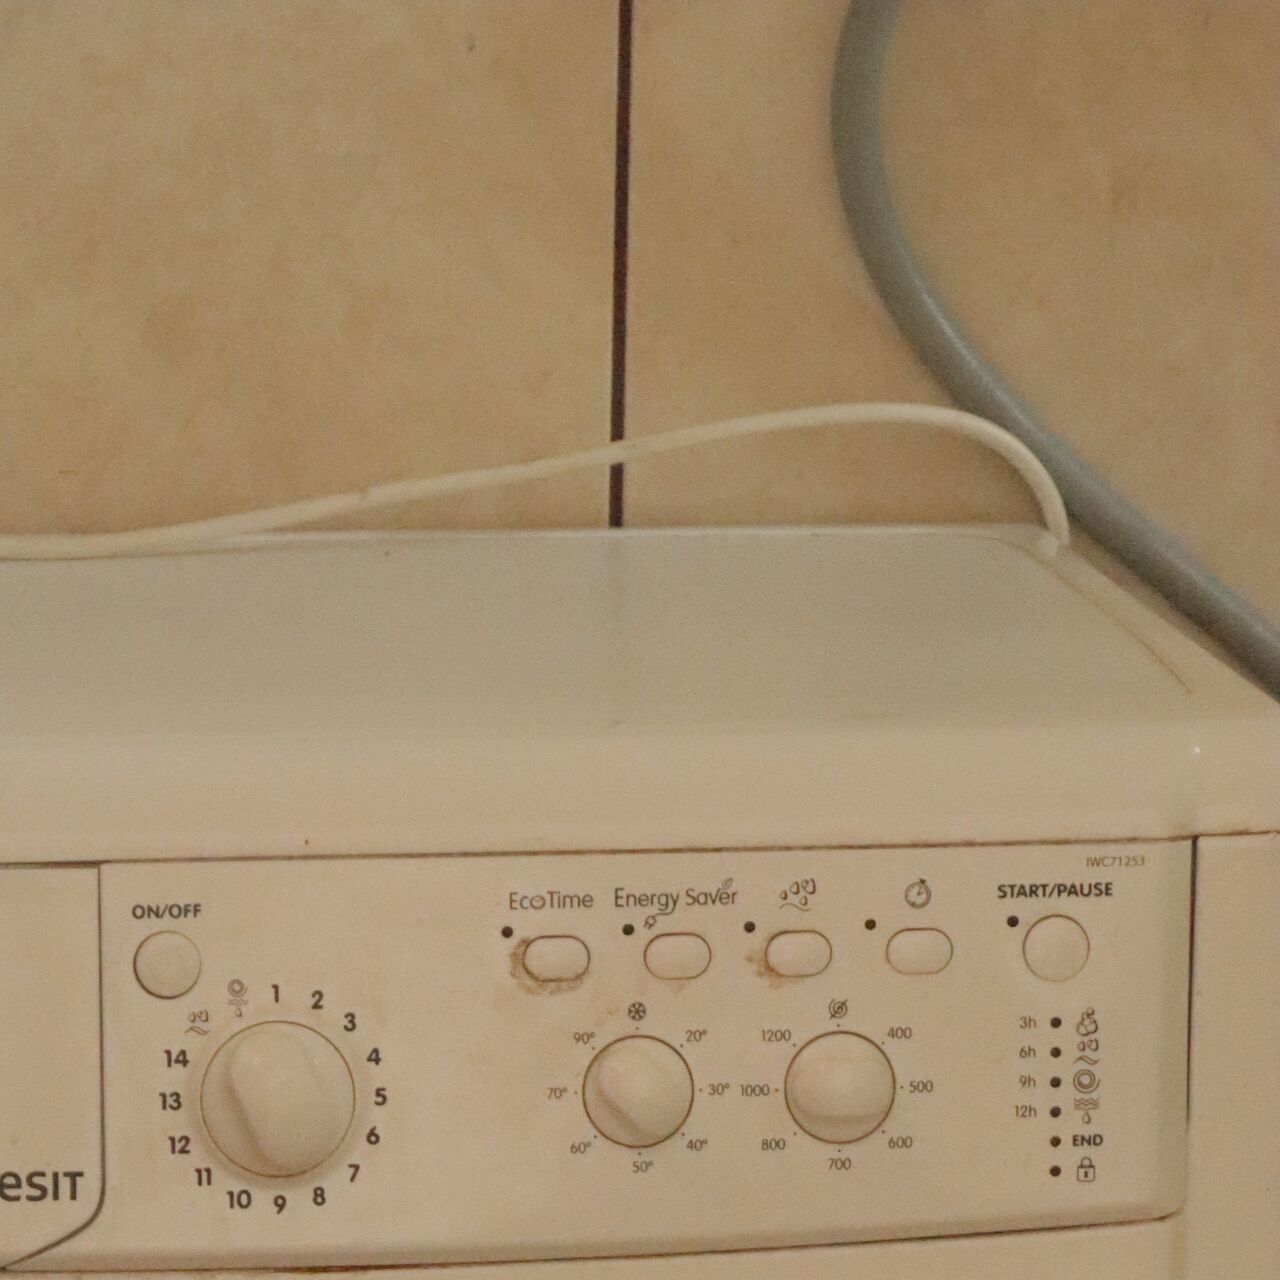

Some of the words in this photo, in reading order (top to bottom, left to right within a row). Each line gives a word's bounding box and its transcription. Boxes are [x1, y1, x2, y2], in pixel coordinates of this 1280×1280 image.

[1086, 855, 1146, 868] IWC71253
[614, 887, 680, 912] Energy
[686, 887, 738, 907] Saver
[997, 881, 1114, 899] START/PAUSE
[508, 890, 595, 911] EcoTime
[131, 903, 202, 920] ON/OFF
[271, 984, 280, 1004] 1
[311, 989, 324, 1010] 2
[343, 1012, 357, 1032] 3
[1019, 1016, 1037, 1029] 3h
[761, 1029, 792, 1043] 1200
[887, 1026, 912, 1040] 400
[163, 1048, 190, 1068] 14
[366, 1047, 382, 1066] 4
[1019, 1045, 1037, 1059] 6h
[739, 1083, 771, 1098] 1000
[908, 1080, 934, 1094] 500
[1019, 1075, 1037, 1089] 9h
[158, 1091, 182, 1111] 13
[373, 1086, 388, 1106] 5
[1014, 1104, 1037, 1119] 12h
[168, 1135, 191, 1155] 12
[366, 1125, 380, 1146] 6
[760, 1137, 786, 1151] 800
[888, 1135, 913, 1149] 600
[1071, 1133, 1104, 1147] END
[347, 1163, 361, 1183] 7
[827, 1157, 852, 1171] 700
[194, 1166, 212, 1187] 11
[226, 1189, 252, 1209] 10
[273, 1194, 287, 1215] 9
[312, 1186, 326, 1207] 8
